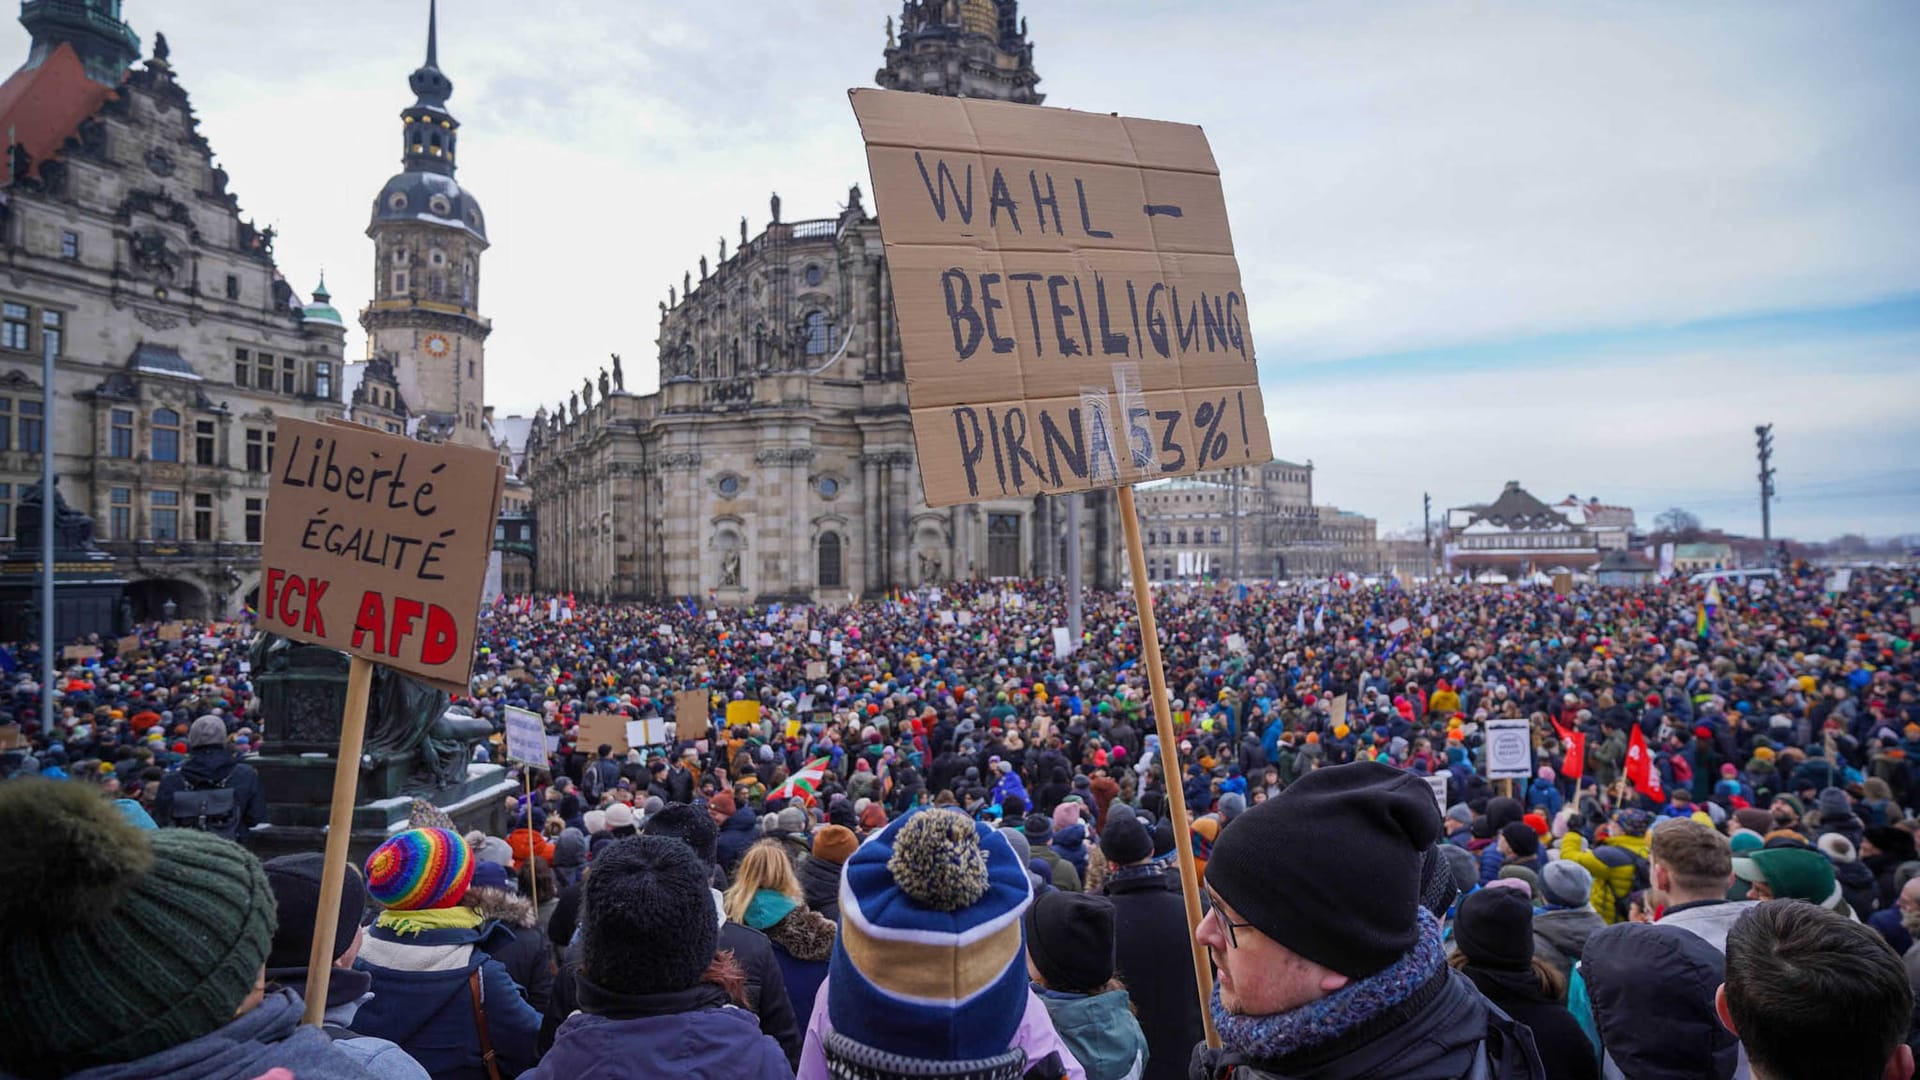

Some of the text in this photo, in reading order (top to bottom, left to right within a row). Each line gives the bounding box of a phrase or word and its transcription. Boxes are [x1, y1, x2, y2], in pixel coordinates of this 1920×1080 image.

[941, 266, 1247, 361] BETEILIGUNG
[283, 436, 447, 516] Liberté
[952, 406, 1119, 496] PIRNA
[302, 507, 456, 580] ÉGALITÉ
[266, 567, 458, 665] FCK AFD
